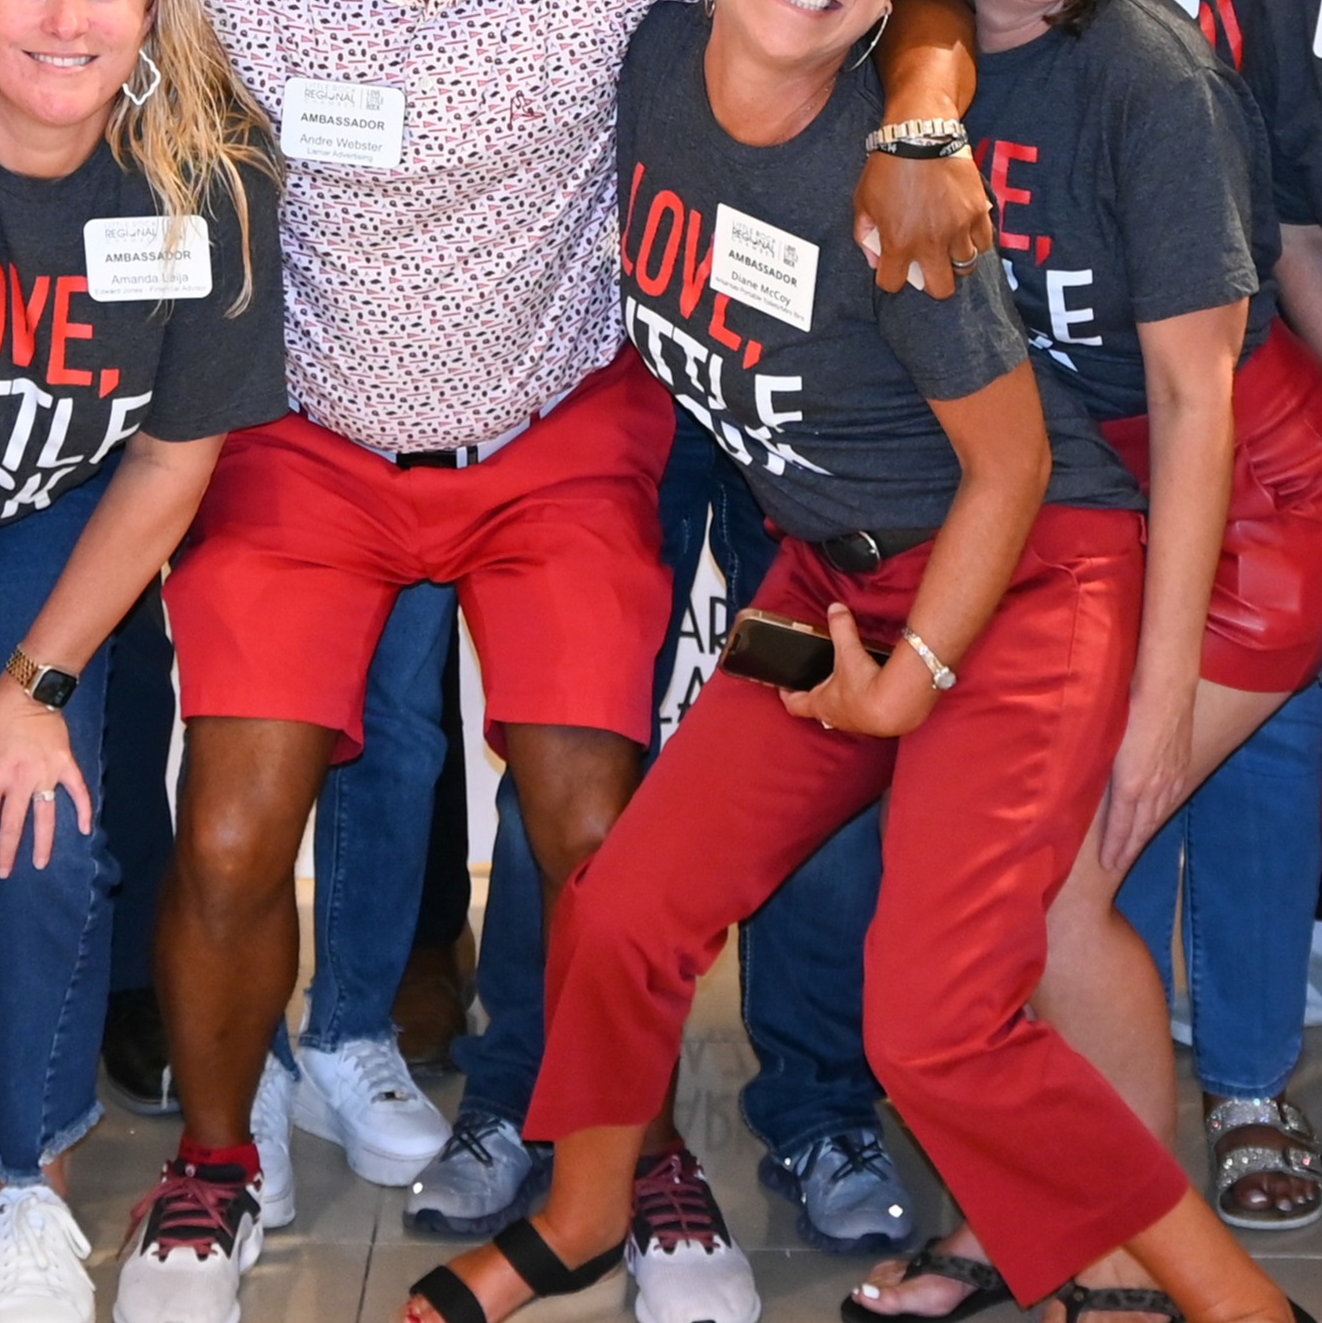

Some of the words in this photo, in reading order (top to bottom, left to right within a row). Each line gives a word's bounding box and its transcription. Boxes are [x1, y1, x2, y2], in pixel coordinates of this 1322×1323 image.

[300, 112, 385, 131] AMBASSADOR
[299, 133, 333, 148] Andre
[336, 137, 383, 153] Webster
[105, 250, 192, 263] AMBASSADOR
[728, 249, 798, 288] AMBASSADOR
[111, 273, 159, 286] Amanda
[731, 270, 759, 290] Diane
[760, 284, 792, 307] McCoy
